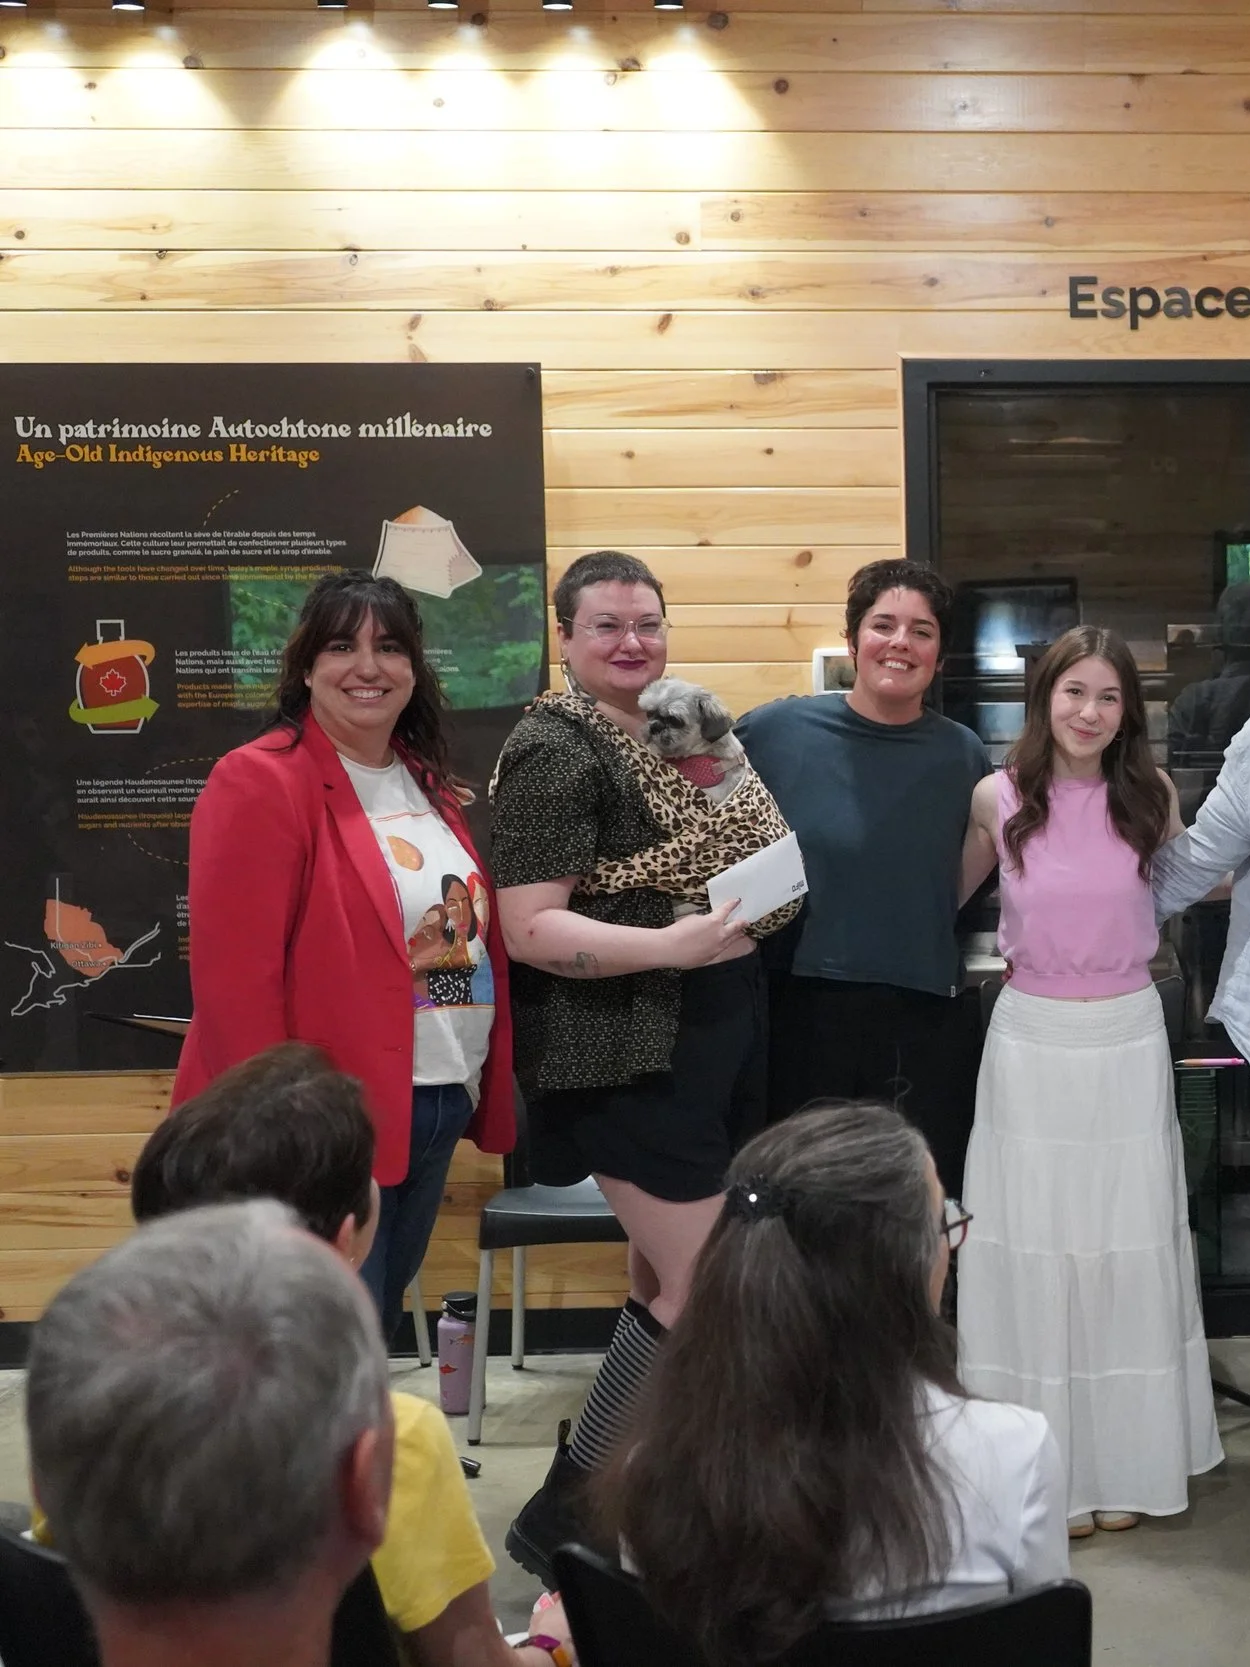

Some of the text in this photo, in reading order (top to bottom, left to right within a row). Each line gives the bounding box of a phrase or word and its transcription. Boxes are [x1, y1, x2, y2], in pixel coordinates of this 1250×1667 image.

[14, 411, 493, 446] Un patrimoine Autochtone millénaire
[109, 444, 224, 469] Indigenous
[228, 444, 320, 469] Heritage
[251, 531, 277, 539] depuis
[292, 531, 316, 539] temps
[187, 540, 226, 548] permettait
[291, 540, 325, 548] plusieurs
[326, 540, 347, 548] types
[78, 549, 112, 557] produits,
[281, 548, 300, 556] sirop
[156, 565, 188, 573] changed
[189, 650, 220, 658] produits
[205, 667, 216, 675] qui
[92, 779, 123, 787] légende
